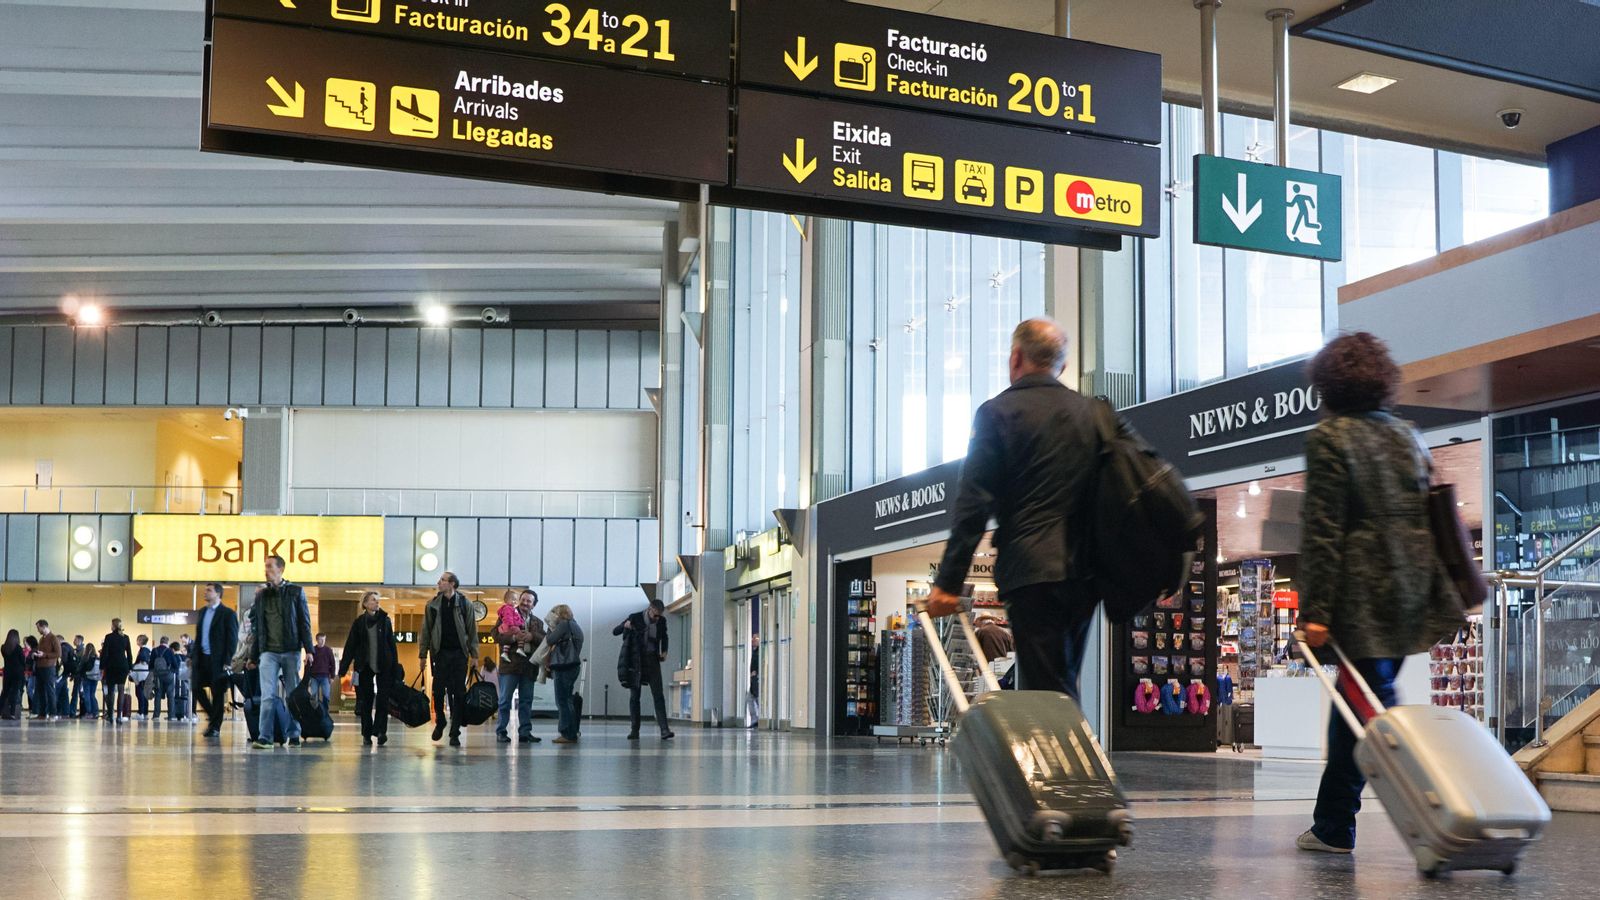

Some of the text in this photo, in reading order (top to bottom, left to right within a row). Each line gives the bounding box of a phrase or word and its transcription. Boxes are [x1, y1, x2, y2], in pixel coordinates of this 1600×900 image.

[394, 4, 528, 41] Facturación
[542, 2, 675, 61] 34 to 21
[603, 38, 616, 53] a
[887, 28, 987, 63] Facturació
[887, 52, 948, 77] Check-in
[454, 70, 564, 103] Arribades
[886, 73, 999, 108] Facturación
[1008, 72, 1096, 124] 20 to 1
[453, 96, 519, 121] Arrivals
[1063, 105, 1074, 120] a
[452, 118, 553, 151] Llegadas
[833, 120, 892, 147] Eixida
[832, 145, 862, 165] Exit
[963, 163, 987, 175] TAXI
[832, 167, 892, 193] Salida
[1016, 175, 1035, 204] P
[1076, 192, 1131, 214] metro
[1189, 400, 1247, 439] NEWS
[1251, 397, 1269, 425] &
[875, 482, 946, 519] NEWS & BOOKS
[197, 533, 319, 564] Bankia
